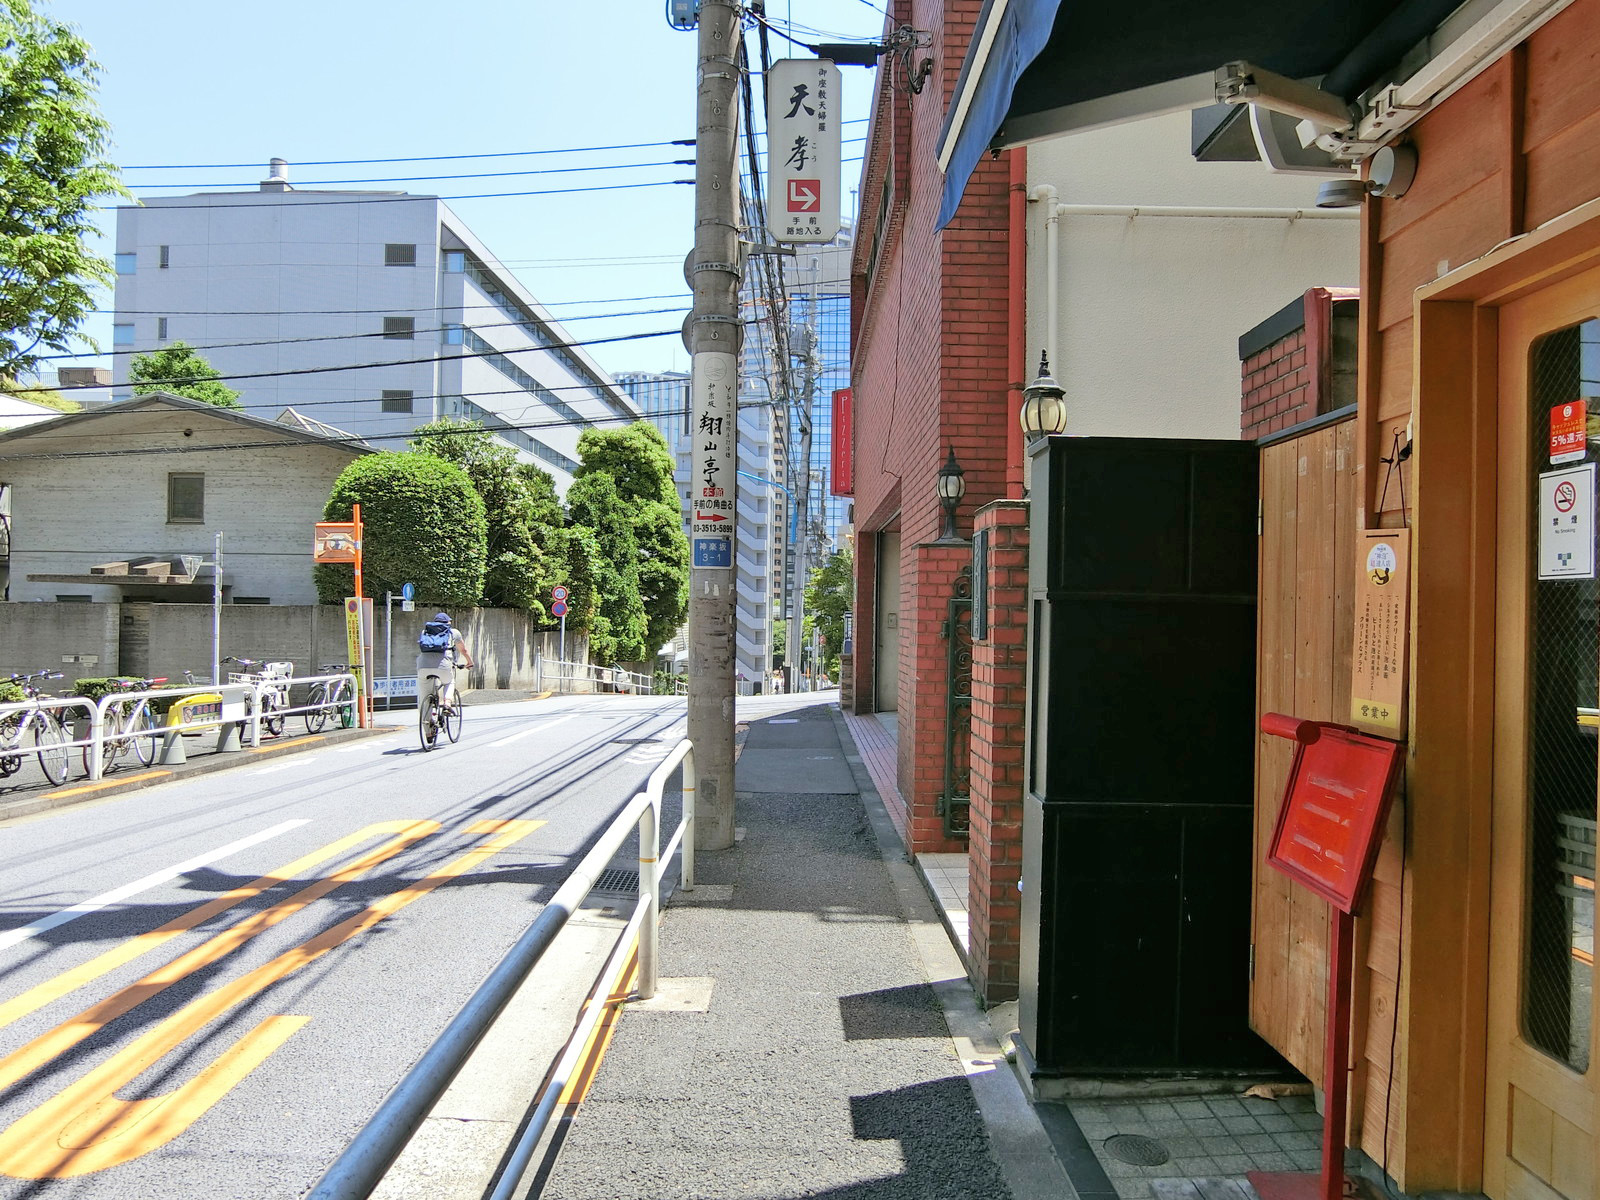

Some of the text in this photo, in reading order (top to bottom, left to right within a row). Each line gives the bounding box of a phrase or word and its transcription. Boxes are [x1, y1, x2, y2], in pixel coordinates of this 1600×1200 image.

[817, 68, 828, 132] 御座敷天婦羅
[783, 83, 816, 171] 天孝
[792, 216, 817, 225] 手前
[786, 227, 822, 236] 路地入る
[840, 396, 848, 487] Pizzeria
[1551, 430, 1584, 447] 5%還元
[699, 411, 723, 487] 翔山亭
[694, 500, 733, 510] 手前の角曲る
[693, 524, 733, 533] 03-3513-5899
[699, 542, 727, 551] 神楽坂
[702, 554, 721, 562] 3-1
[555, 589, 565, 597] 20
[1360, 704, 1389, 721] 営業中
